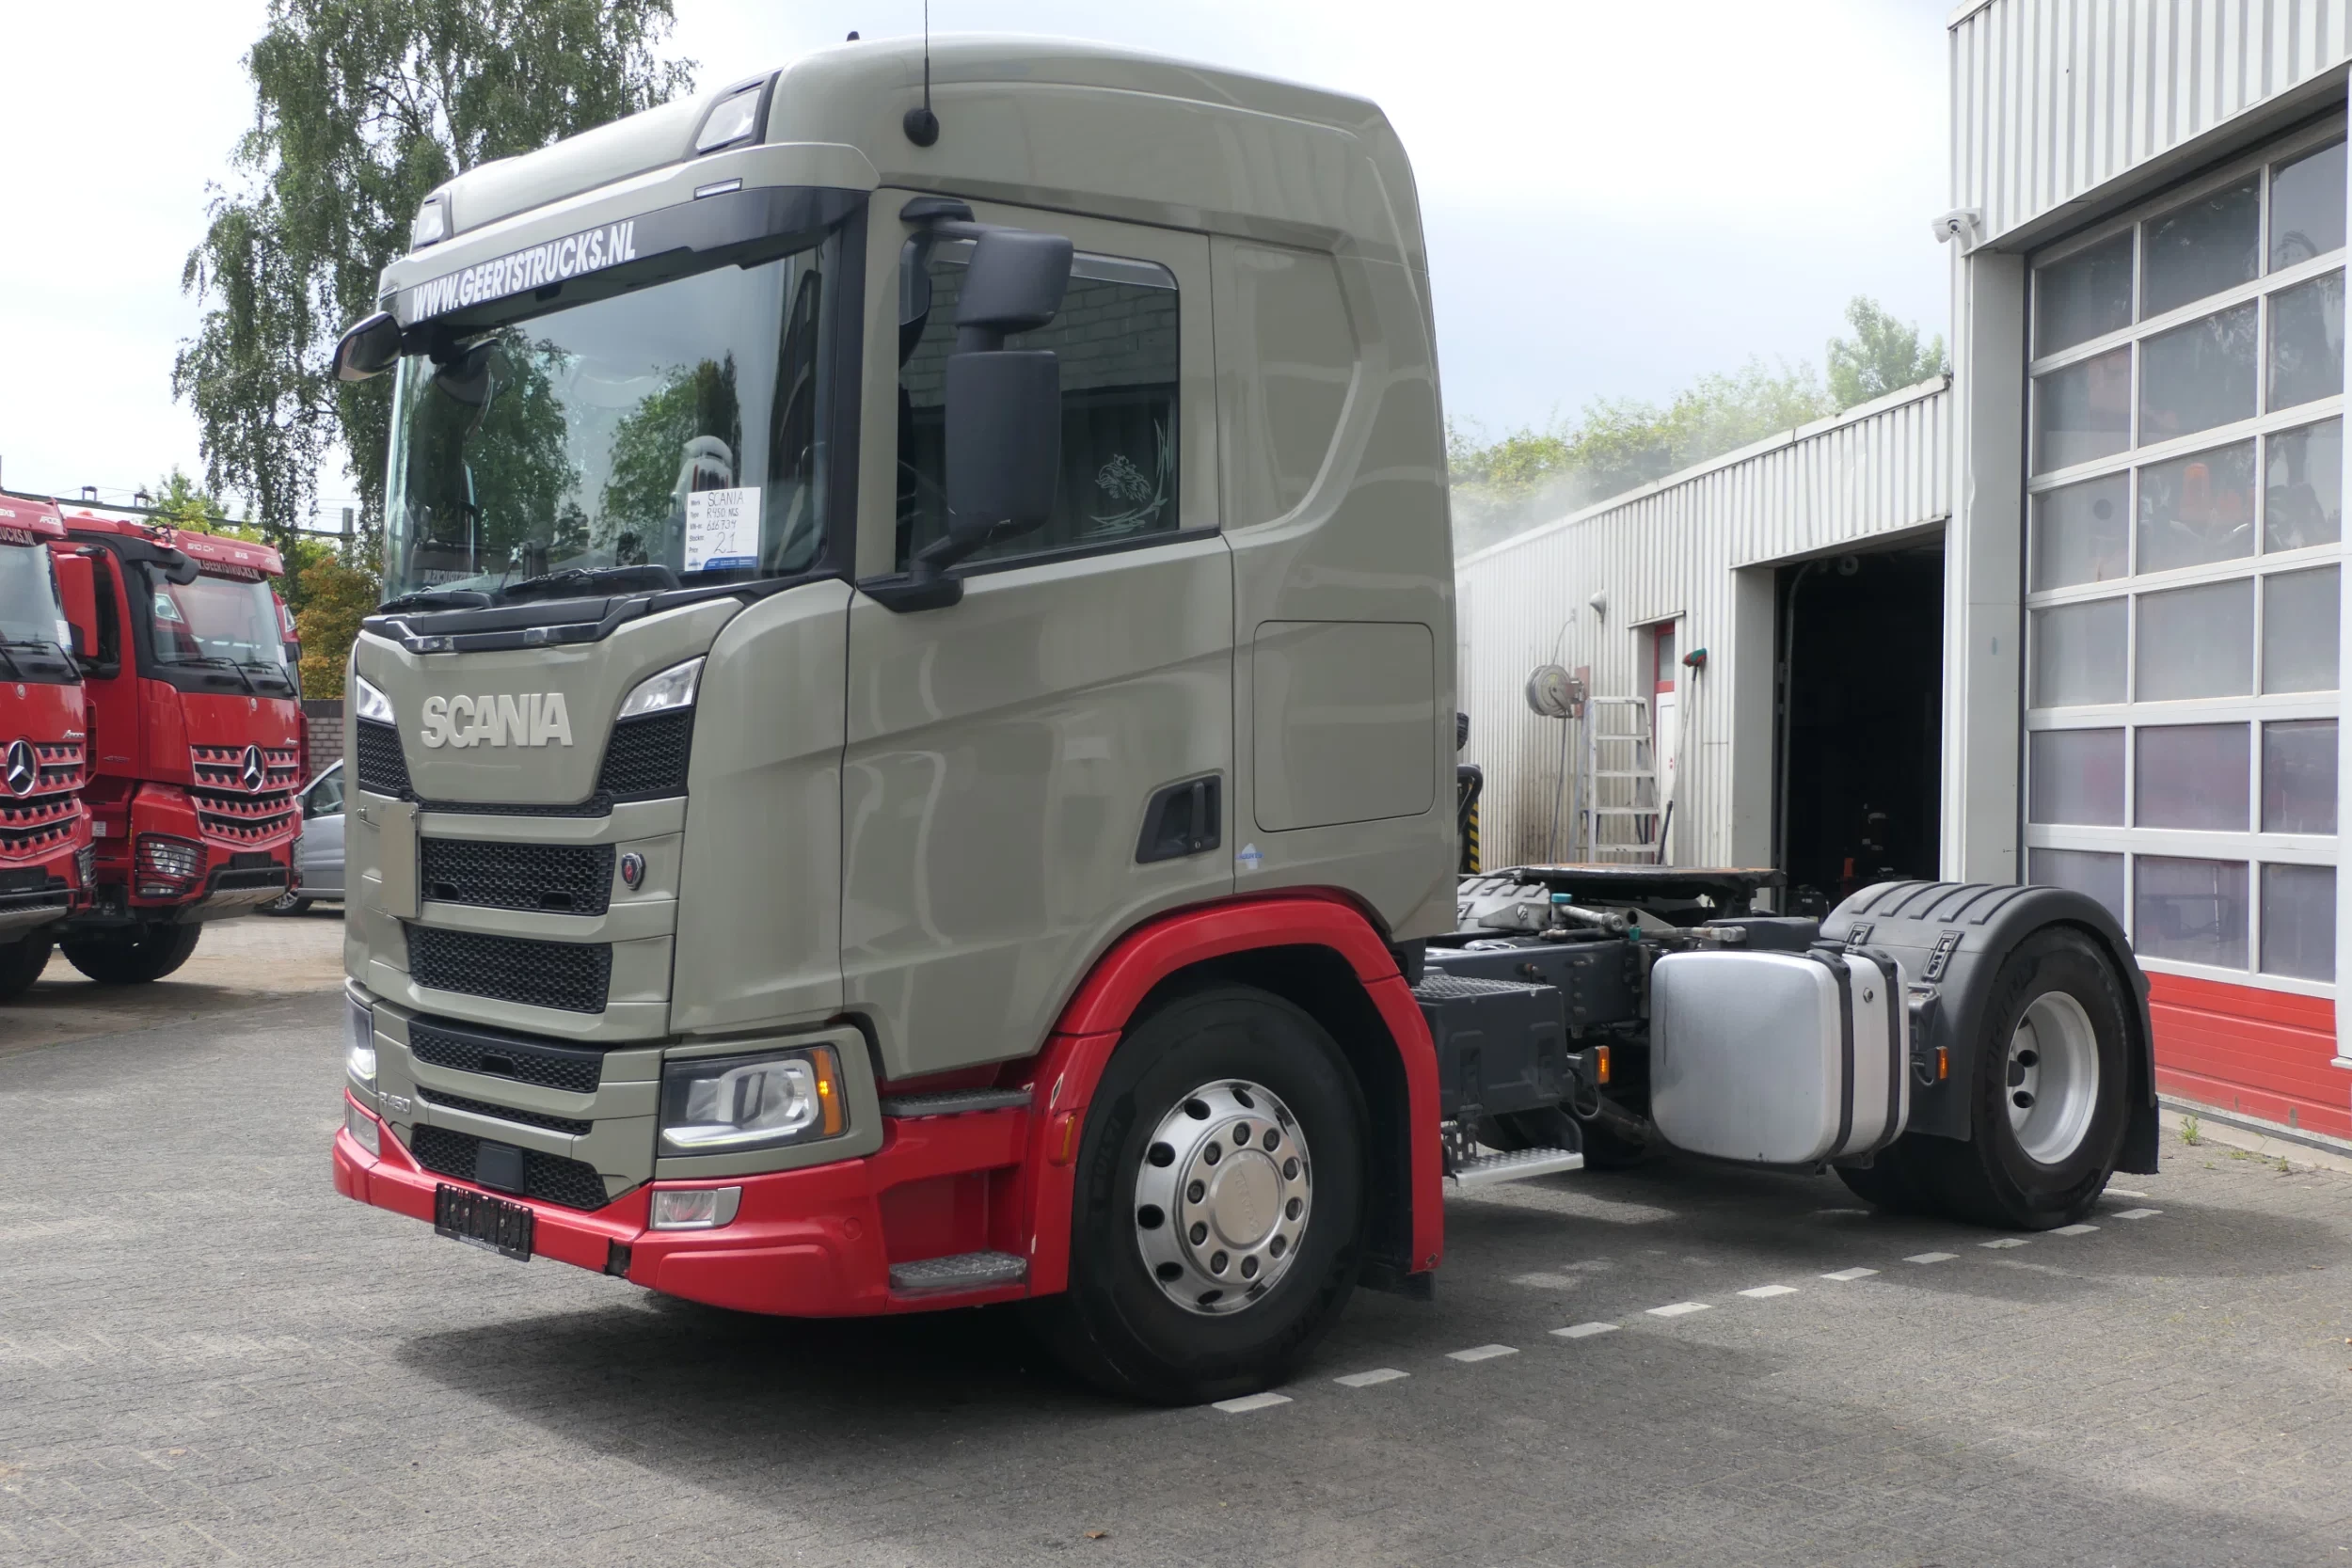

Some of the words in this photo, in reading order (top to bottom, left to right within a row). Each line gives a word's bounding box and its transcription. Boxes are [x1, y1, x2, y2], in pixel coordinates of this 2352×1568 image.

[412, 220, 636, 322] WWW.GEERTSTRUCKS.NL
[707, 491, 744, 507] SCANIA
[707, 508, 725, 518] R450
[714, 531, 739, 554] 21
[421, 692, 573, 749] SCANIA
